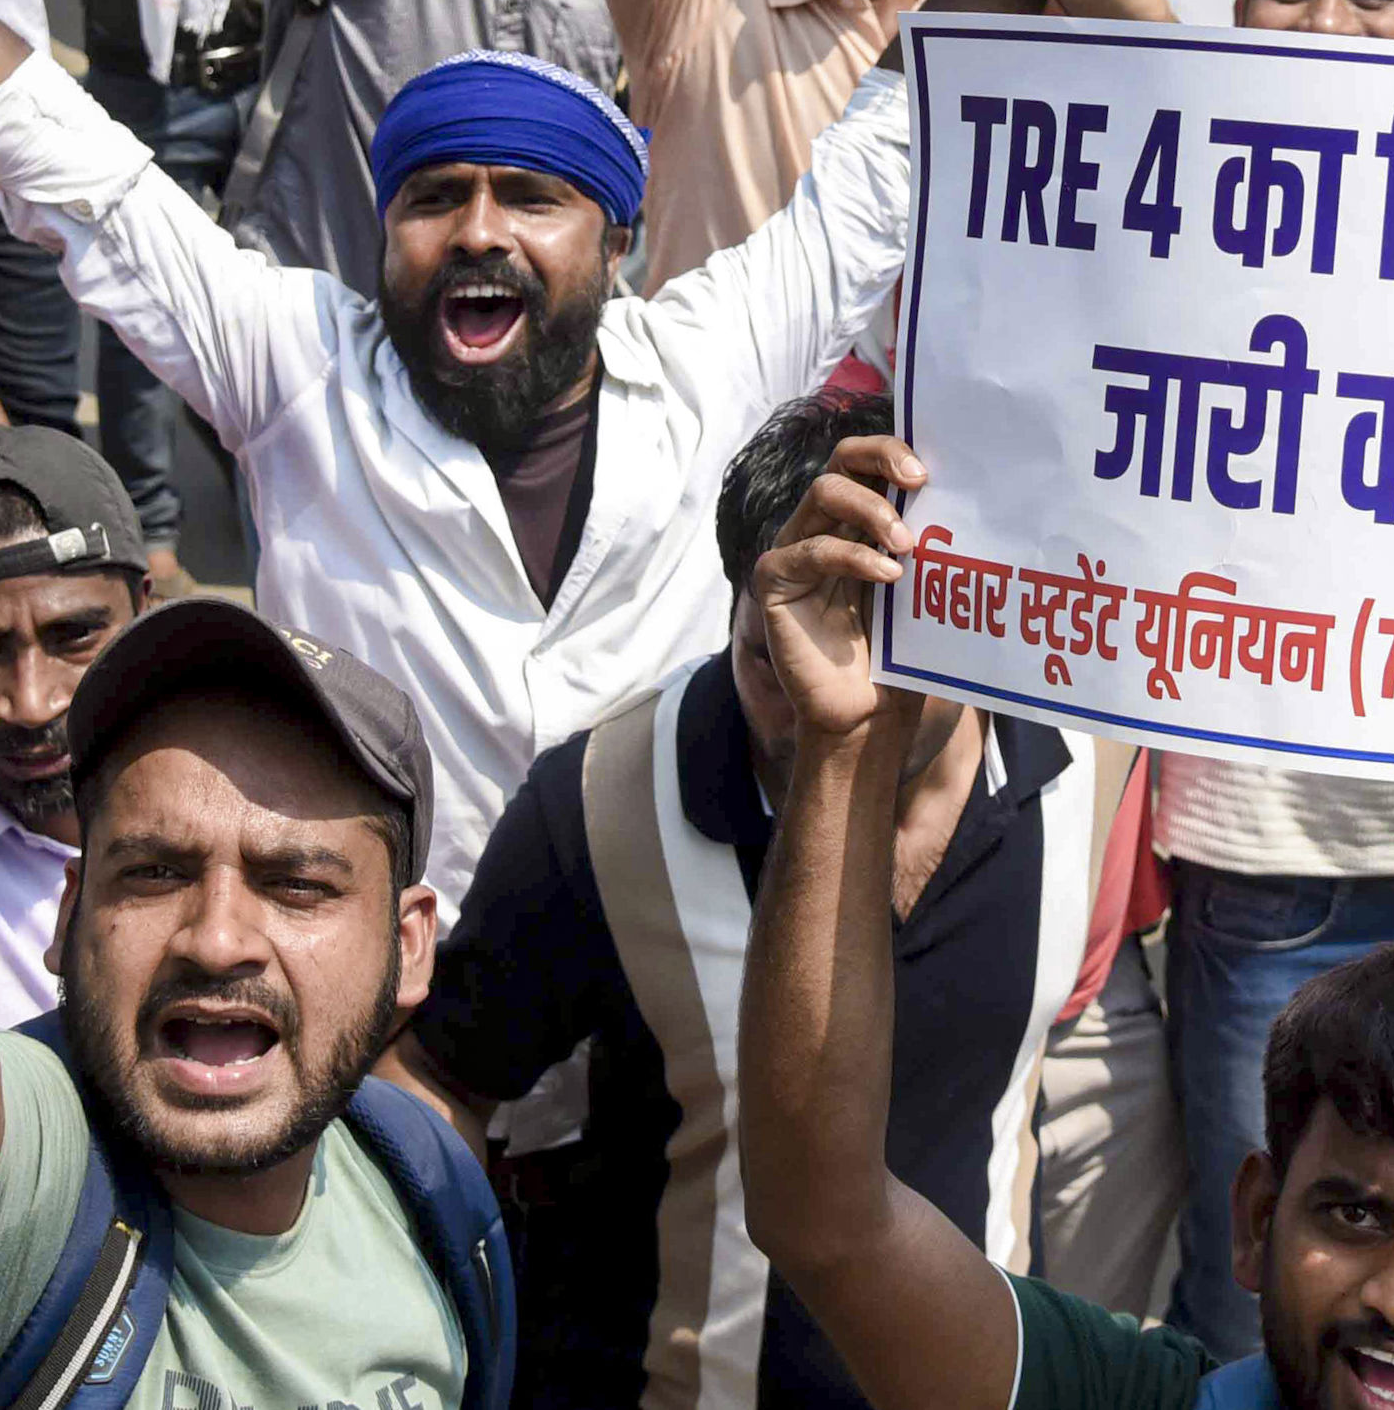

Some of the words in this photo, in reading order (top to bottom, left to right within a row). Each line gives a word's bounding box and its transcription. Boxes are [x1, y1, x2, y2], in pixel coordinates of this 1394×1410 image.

[960, 94, 1109, 250] TRE
[1121, 109, 1182, 259] 4
[1208, 117, 1359, 276] का
[1091, 313, 1321, 515] जारी
[911, 524, 1014, 638] बिहार
[1018, 552, 1129, 686] स्टूडेंट
[1133, 570, 1337, 701] यूनियन
